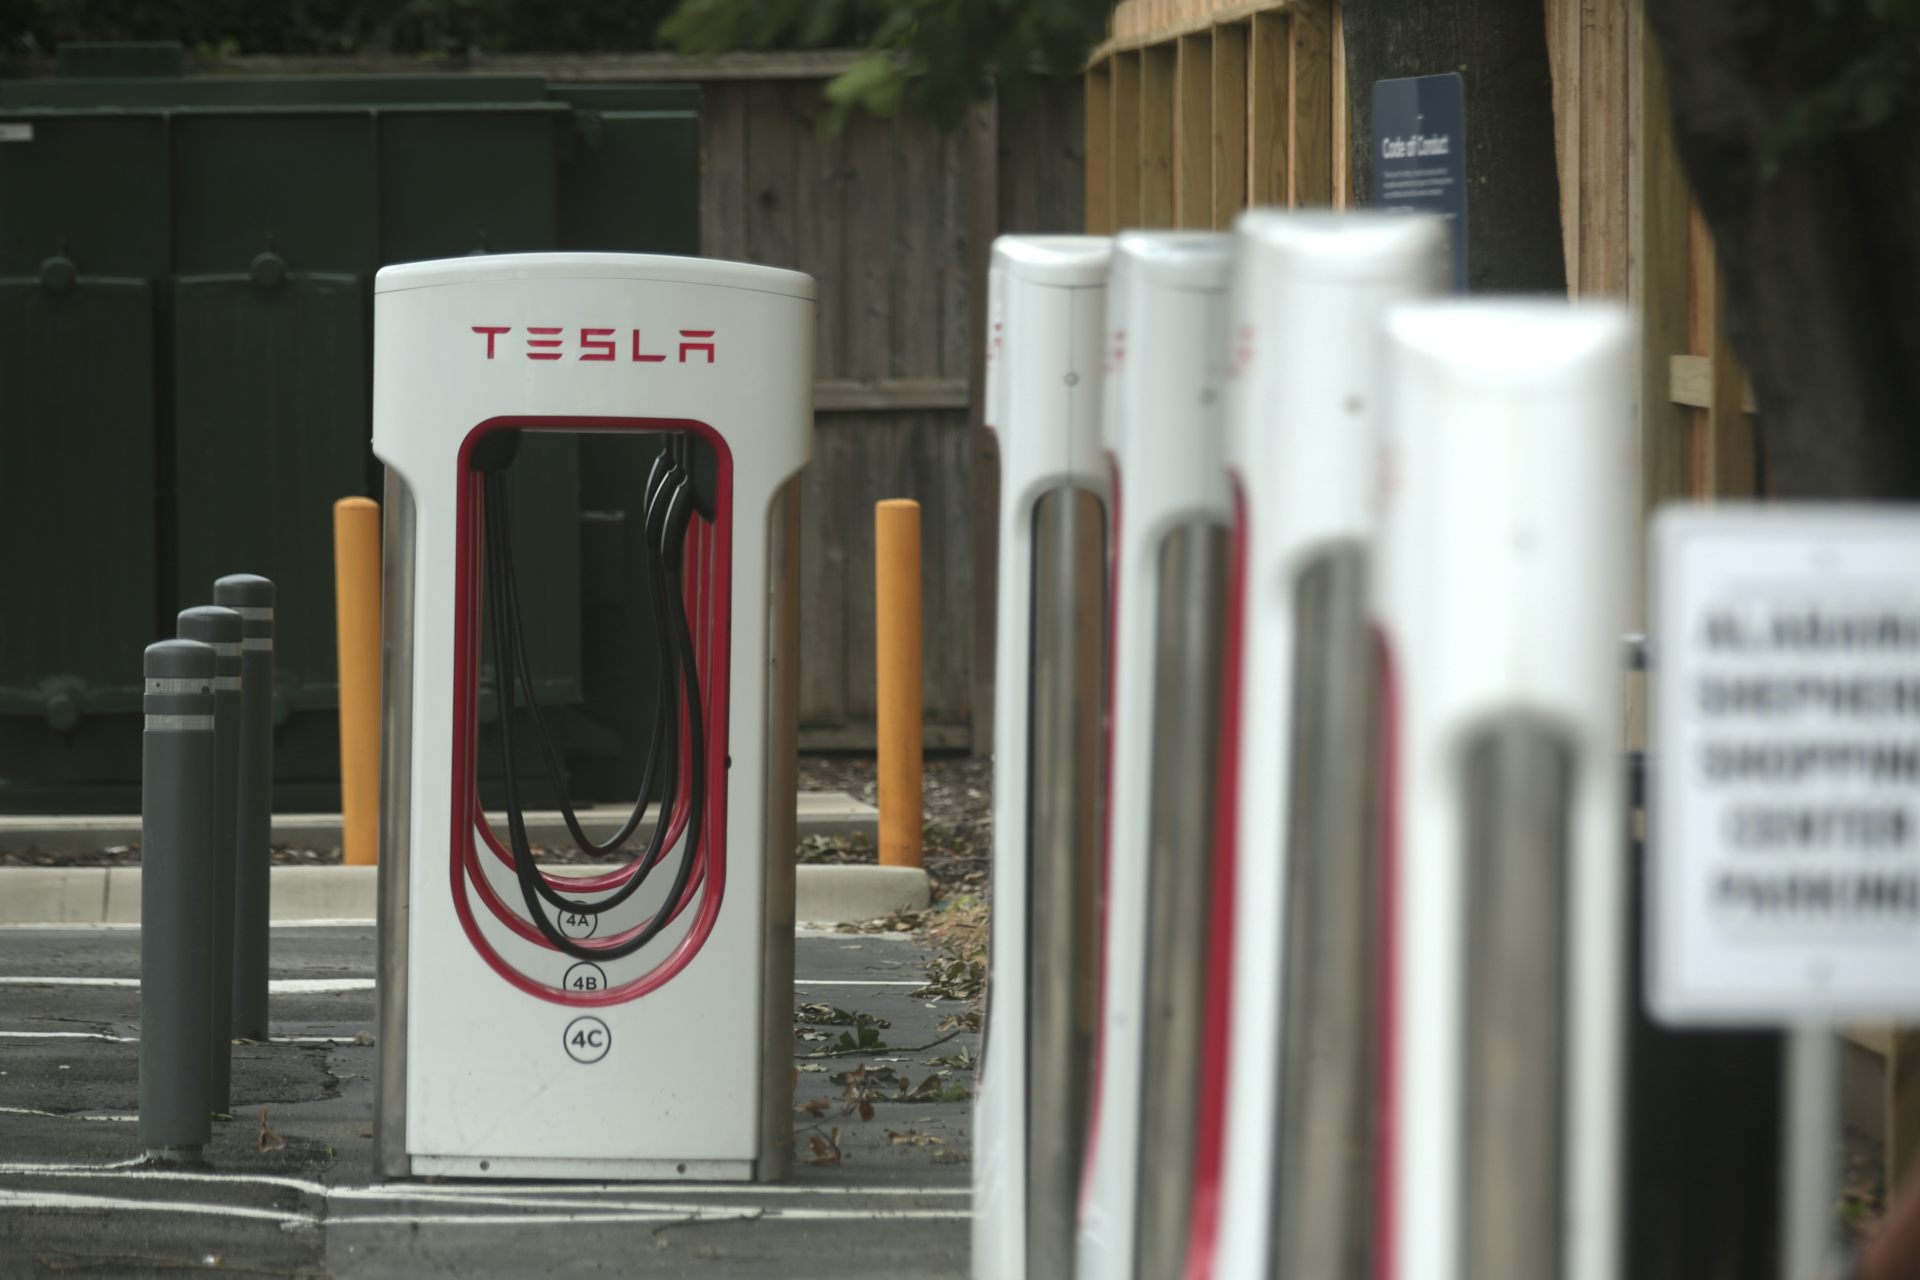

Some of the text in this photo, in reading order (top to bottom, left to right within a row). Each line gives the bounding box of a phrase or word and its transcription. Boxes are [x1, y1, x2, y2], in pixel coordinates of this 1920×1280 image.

[1382, 134, 1449, 158] Code of Conduct
[471, 326, 715, 363] TESLA
[566, 914, 589, 927] 4A
[573, 976, 597, 991] 4B
[571, 1029, 603, 1048] 4C
